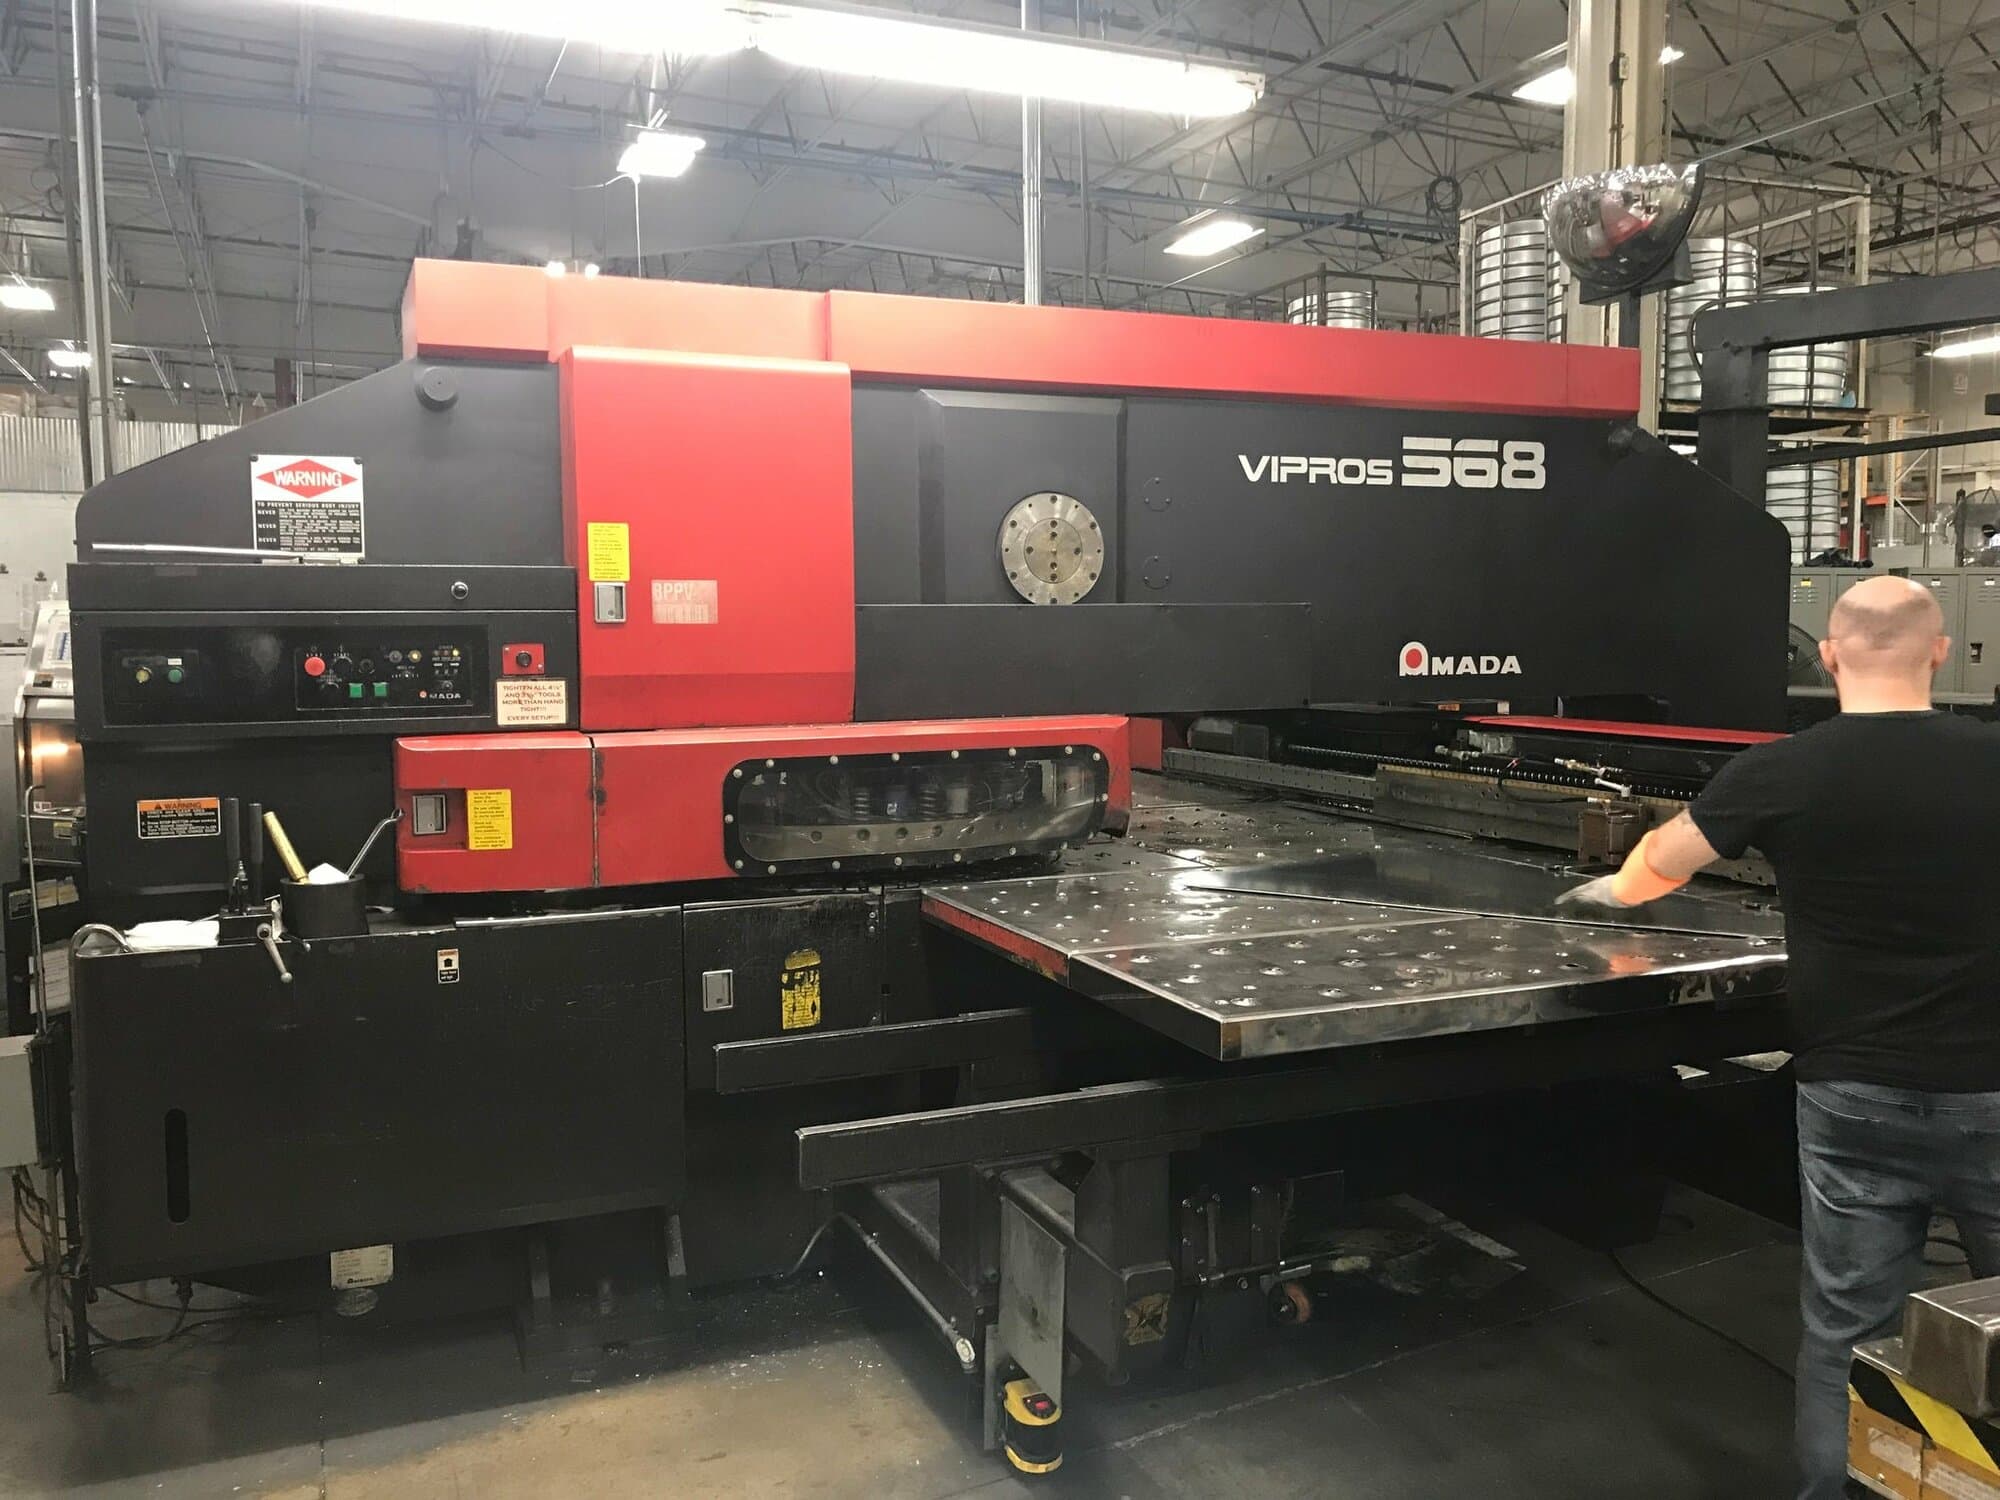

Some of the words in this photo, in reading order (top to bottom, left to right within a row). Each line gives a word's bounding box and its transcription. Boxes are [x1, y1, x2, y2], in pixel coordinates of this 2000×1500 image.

[273, 470, 342, 487] WARNING
[1238, 454, 1393, 486] VIPROS
[1401, 436, 1546, 490] 568
[1398, 641, 1522, 676] AMADA
